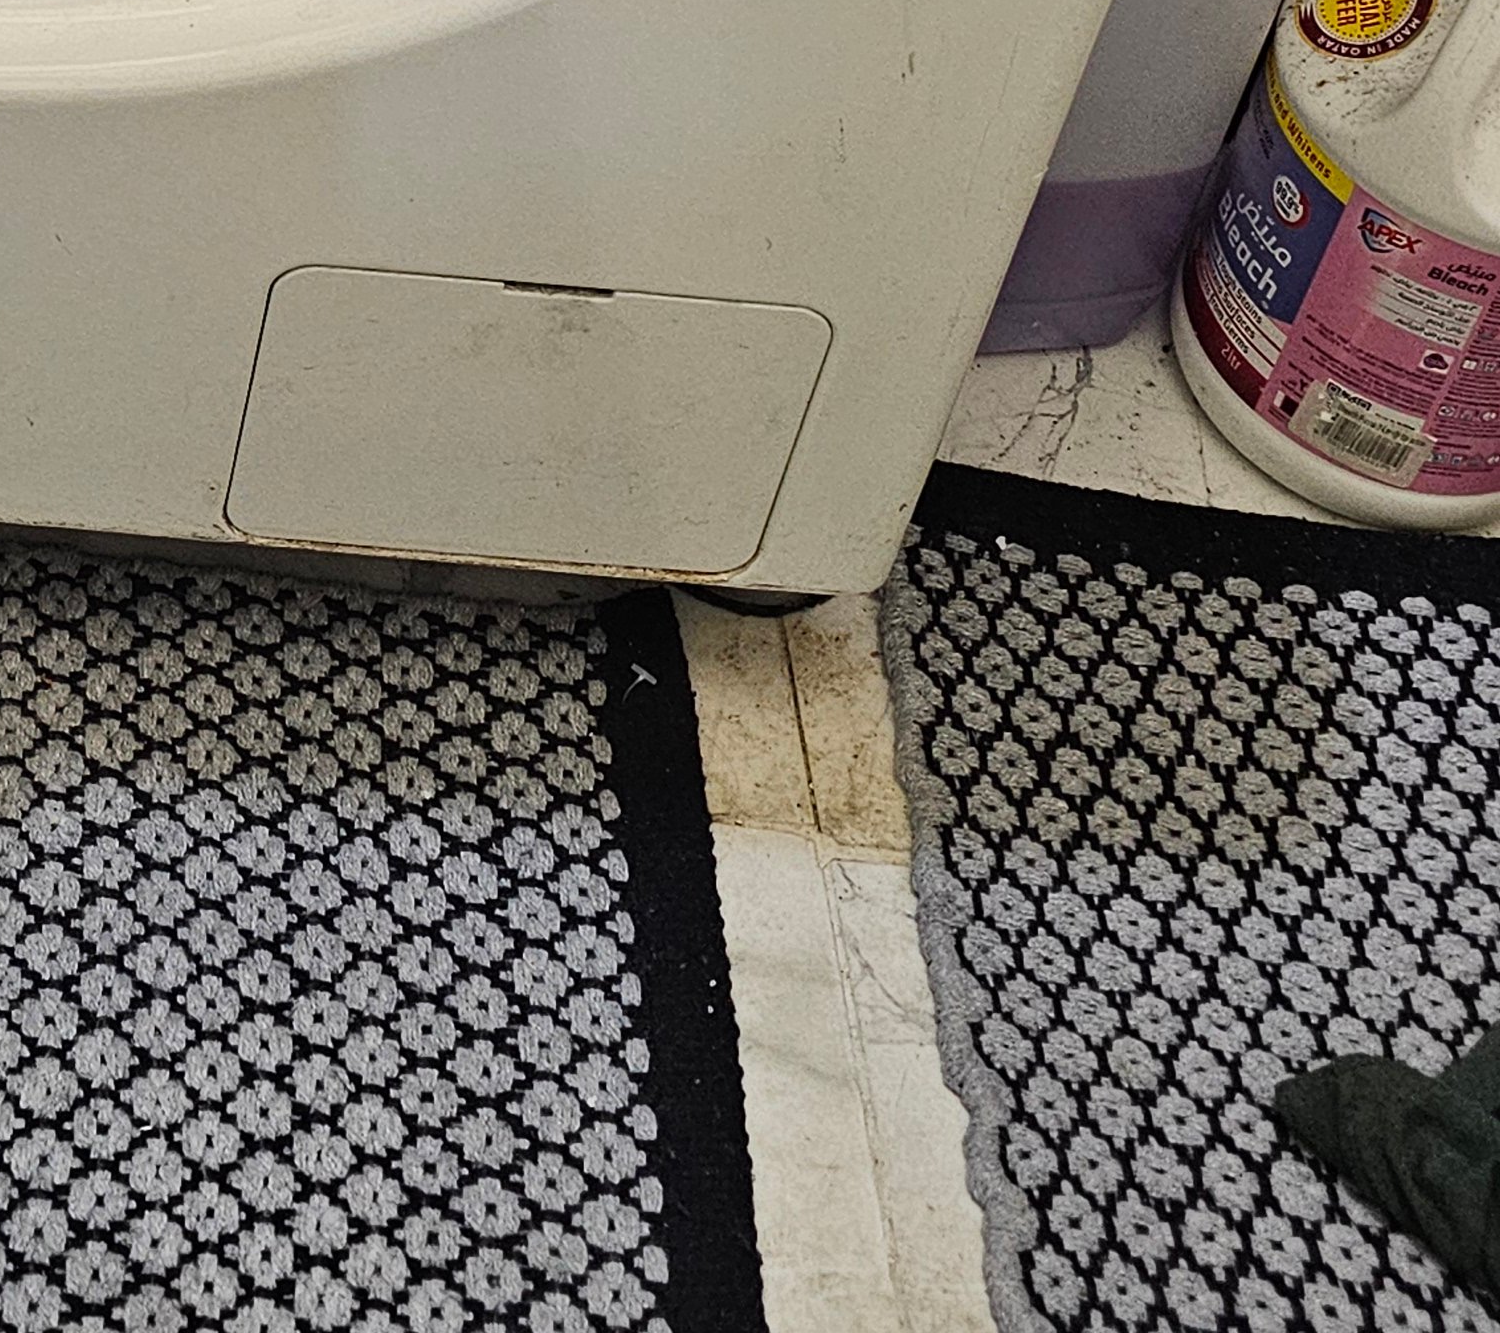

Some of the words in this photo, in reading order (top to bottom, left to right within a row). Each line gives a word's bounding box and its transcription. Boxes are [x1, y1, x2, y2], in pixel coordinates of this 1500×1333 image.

[1316, 34, 1362, 57] QATAR
[1367, 43, 1383, 56] IN
[1387, 18, 1422, 49] MADE
[1287, 117, 1332, 179] Whitens
[1219, 189, 1278, 300] Bleach
[1357, 219, 1424, 255] APEX
[1427, 265, 1490, 297] Bleach
[1221, 291, 1256, 340] Surfaces
[1234, 286, 1263, 324] Stains
[1223, 318, 1249, 355] Germs
